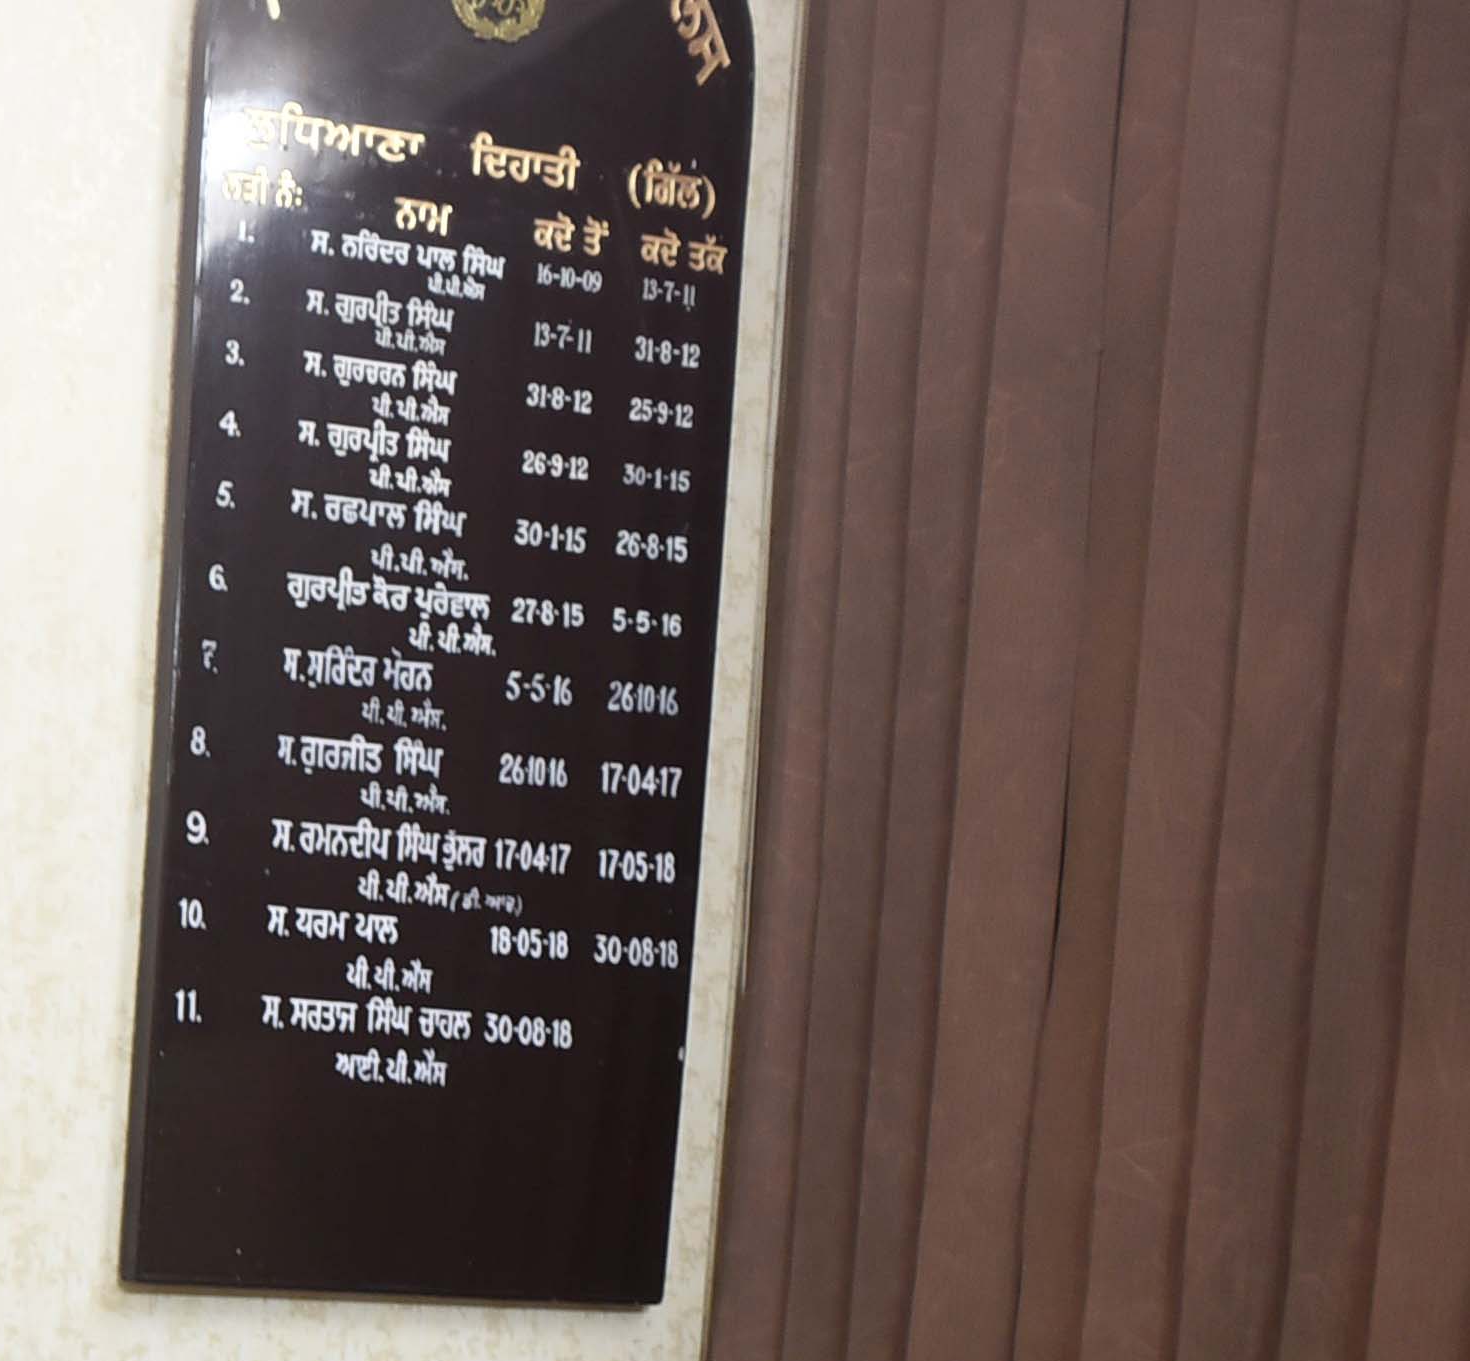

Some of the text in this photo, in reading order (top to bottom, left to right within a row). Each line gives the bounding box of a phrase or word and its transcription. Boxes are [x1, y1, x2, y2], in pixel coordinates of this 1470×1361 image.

[470, 131, 581, 191] ਦਿਹਾਤੀ
[394, 196, 454, 237] ਨਾਮ
[416, 245, 457, 273] ਪਾਲ
[462, 243, 506, 280] ਸਿੰਘ
[535, 262, 603, 294] 16-10-09
[642, 277, 696, 308] 13-7-11
[229, 279, 251, 305] 2.
[407, 297, 455, 333] ਸਿੰਘ
[533, 321, 593, 355] 13-7-11
[634, 335, 701, 369] 31-8-12
[224, 339, 245, 367] 3.
[411, 359, 459, 395] ਸਿੰਘ
[526, 382, 593, 416] 31-8-12
[628, 396, 695, 429] 25-9-12
[218, 410, 242, 437] 4.
[406, 425, 452, 463] ਸਿੰਘ
[522, 449, 589, 481] 26-9-12
[622, 463, 692, 493] 30-1-15
[215, 480, 236, 510] 5.
[413, 498, 468, 538] ਸਿੰਘ
[514, 518, 587, 554] 30-1-15
[615, 529, 689, 564] 26-8-15
[208, 563, 229, 592] 6.
[511, 596, 585, 629] 27-8-15
[612, 606, 683, 638] 5-5-16
[505, 670, 573, 707] 5-5-16
[189, 725, 211, 758] 8.
[394, 735, 444, 778] ਸਿੰਘ
[185, 810, 210, 847] 9.
[397, 821, 440, 866] ਸਿੰਘ
[178, 898, 207, 931] 10.
[355, 912, 399, 945] ਪਾਲ
[174, 988, 202, 1024] 11.
[366, 995, 413, 1038] ਸਿੰਘ
